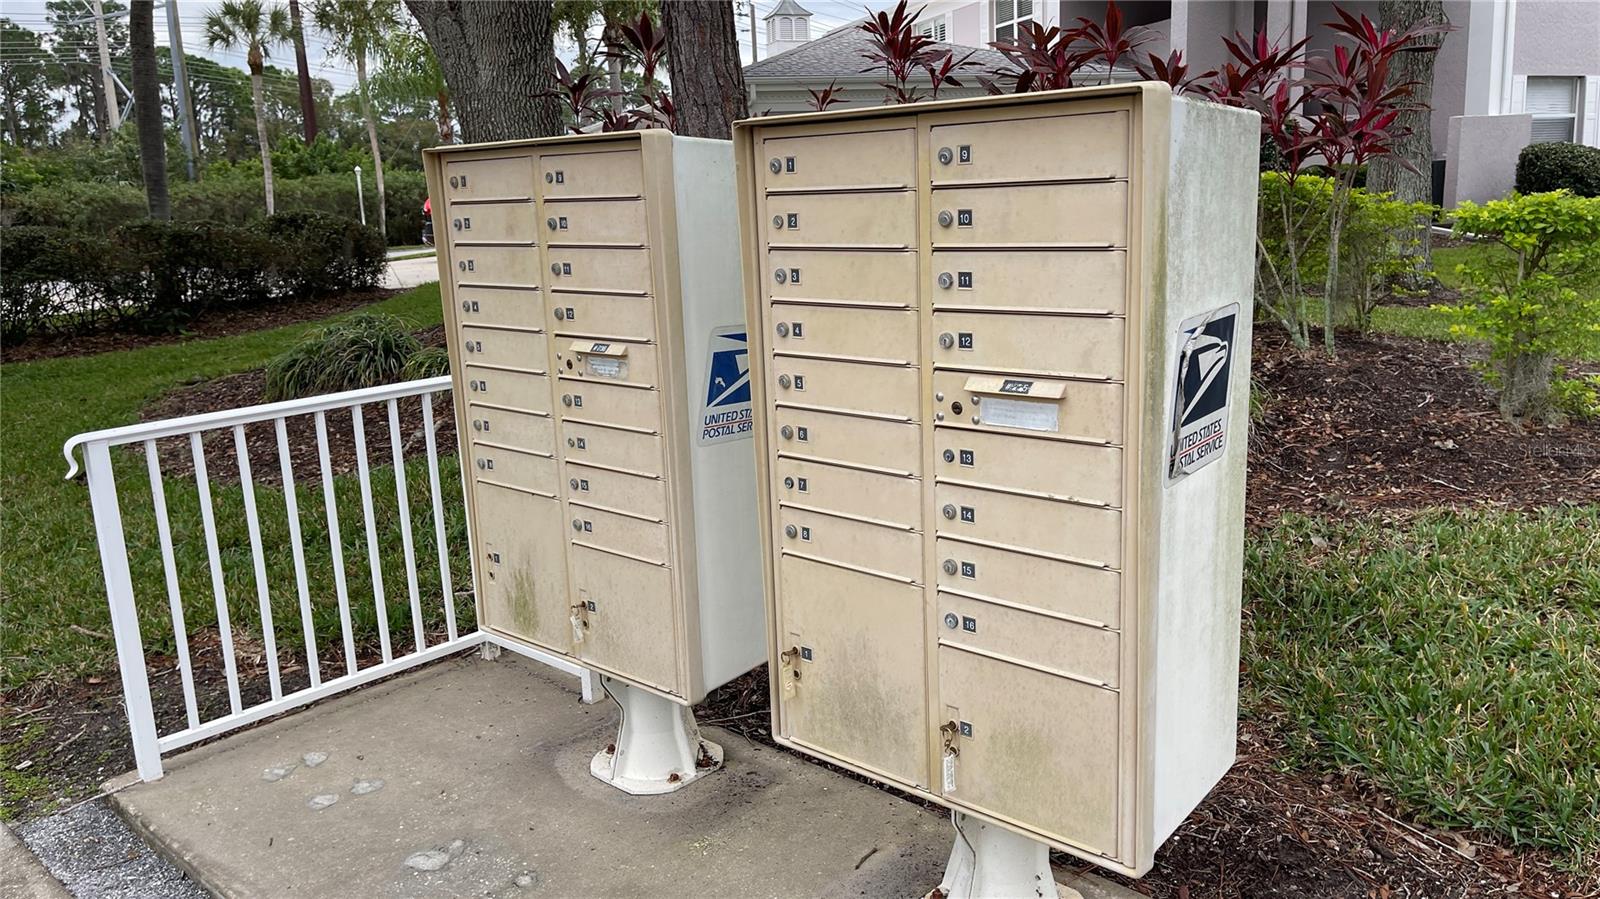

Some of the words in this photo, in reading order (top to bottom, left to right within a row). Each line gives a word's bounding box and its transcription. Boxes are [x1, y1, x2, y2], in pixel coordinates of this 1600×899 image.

[961, 150, 968, 159] 9
[960, 214, 970, 223] 10
[792, 272, 798, 280] 3
[961, 276, 969, 285] 11
[794, 326, 800, 334] 4
[961, 336, 971, 346] 12
[704, 410, 738, 426] UNITED
[702, 425, 735, 440] POSTAL
[799, 430, 805, 438] 6
[1170, 431, 1198, 459] UITED
[1198, 418, 1222, 442] STATES
[962, 454, 972, 463] 13
[1169, 450, 1195, 478] PSTAL
[1196, 435, 1223, 461] SERVICE
[962, 511, 972, 519] 14
[963, 566, 973, 575] 15
[966, 621, 975, 630] 16
[964, 726, 970, 734] 2
